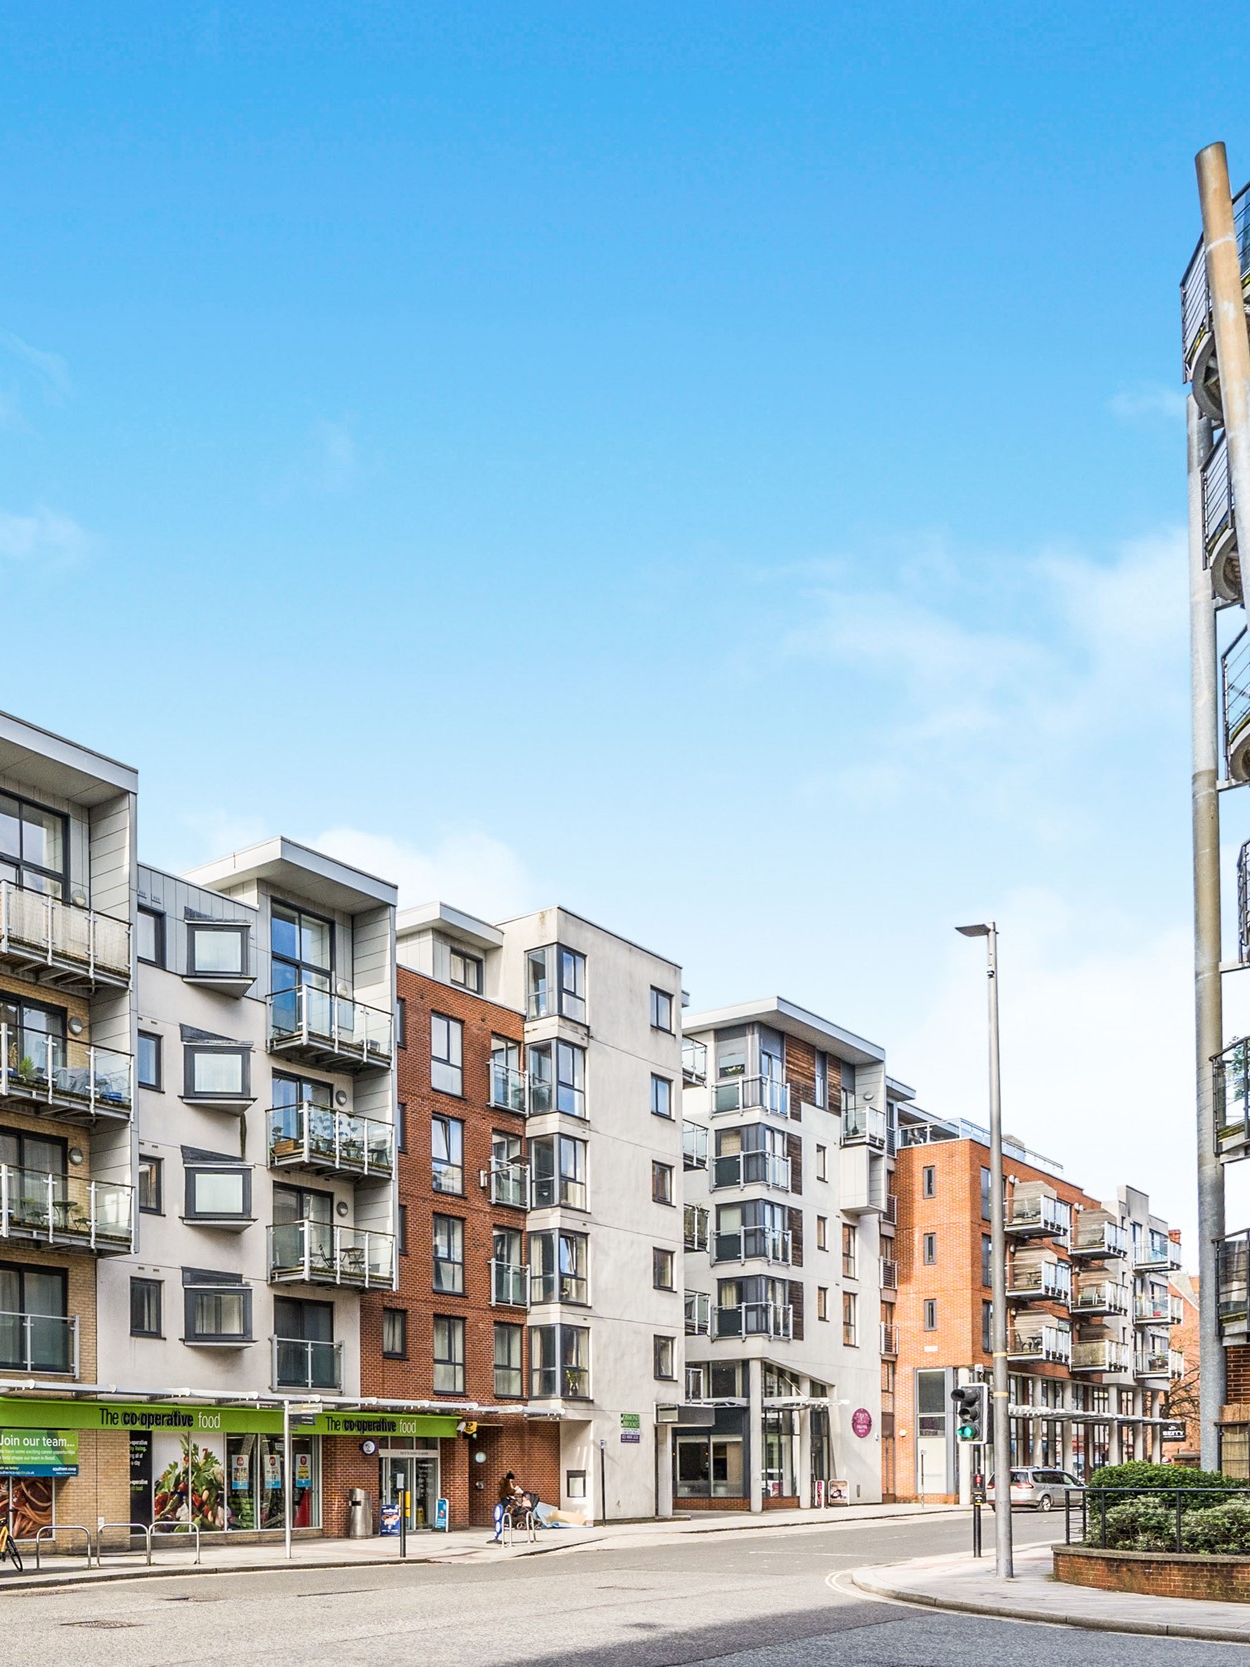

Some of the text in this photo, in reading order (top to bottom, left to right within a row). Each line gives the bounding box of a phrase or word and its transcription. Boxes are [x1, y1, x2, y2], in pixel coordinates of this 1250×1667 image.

[99, 1408, 221, 1429] The co-operative food
[326, 1416, 341, 1431] The
[399, 1419, 417, 1434] food
[23, 1437, 40, 1446] our
[43, 1436, 75, 1447] team...
